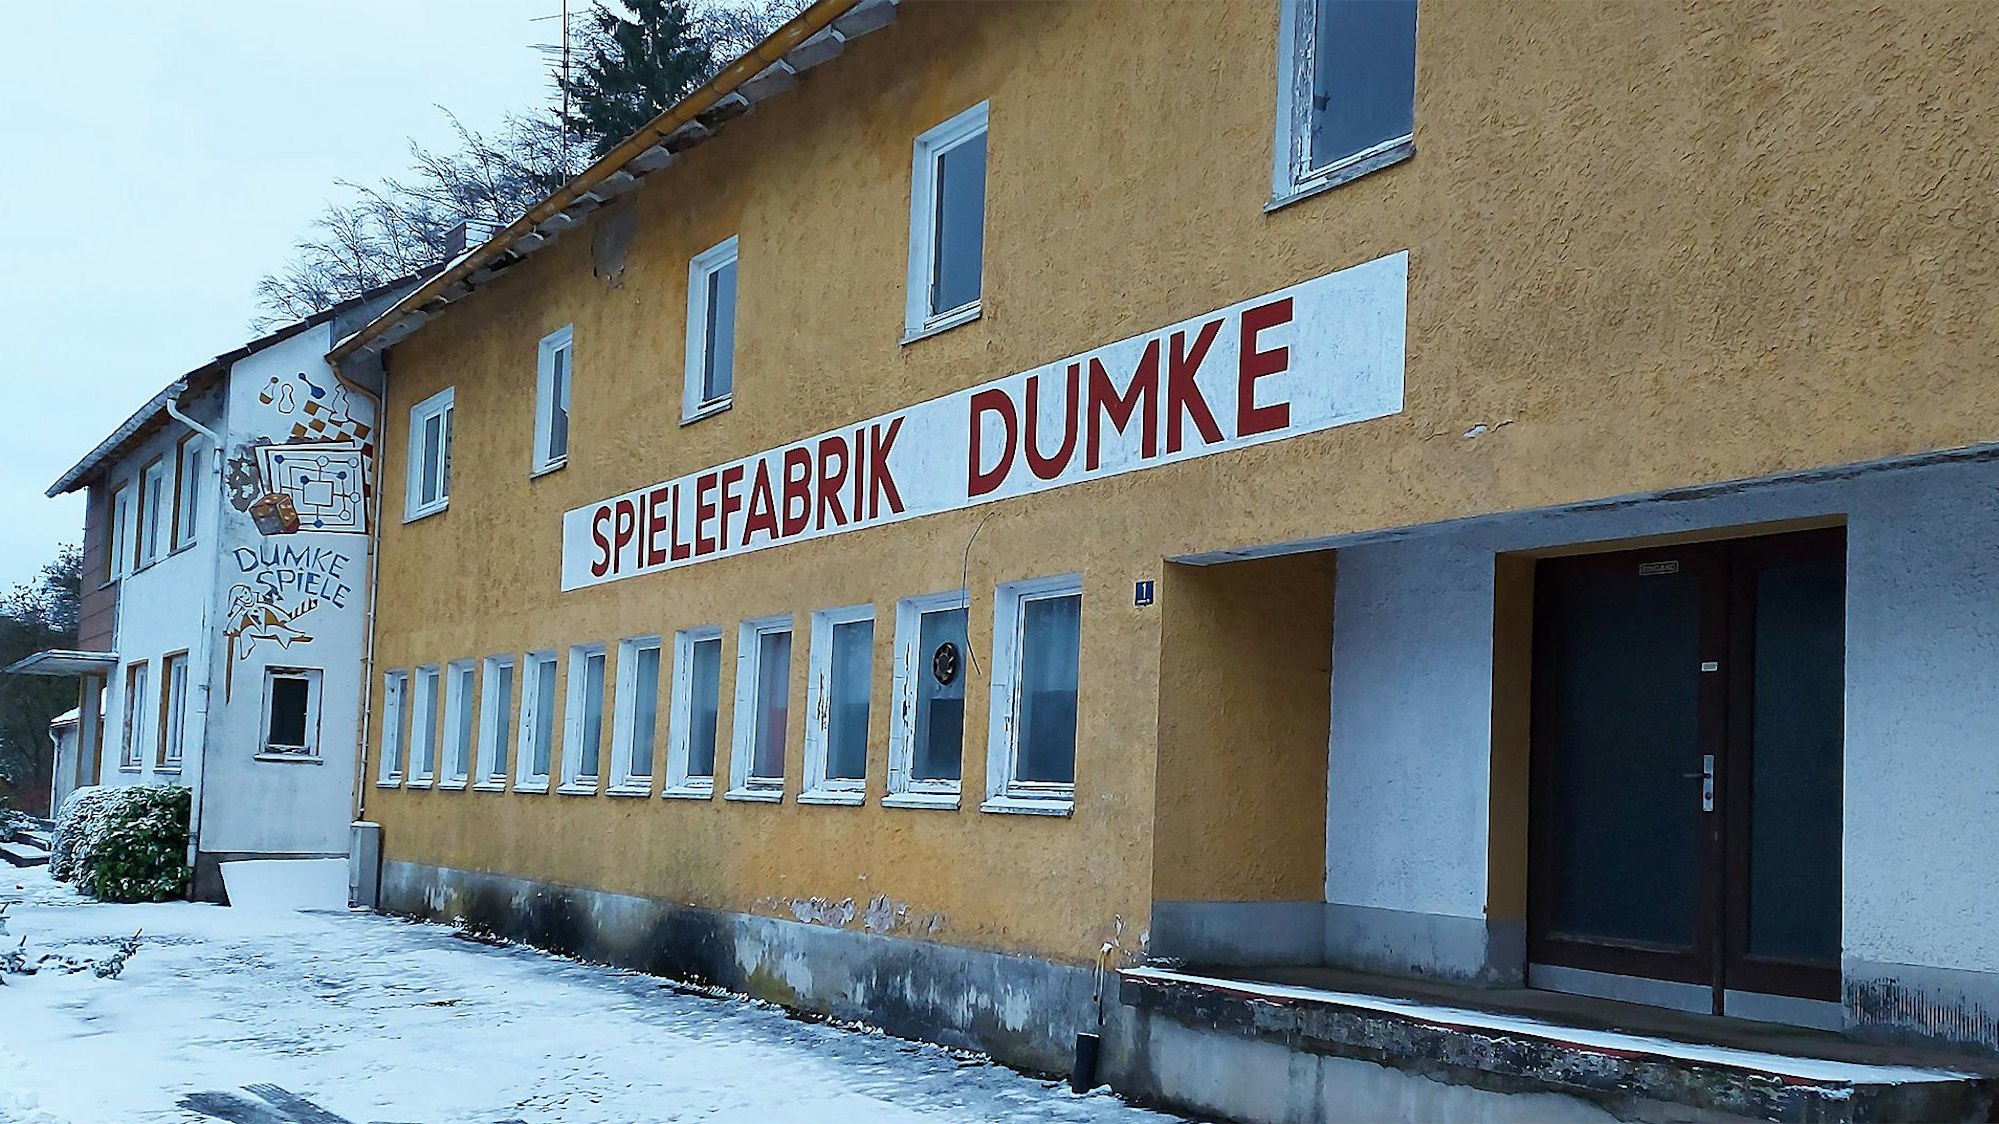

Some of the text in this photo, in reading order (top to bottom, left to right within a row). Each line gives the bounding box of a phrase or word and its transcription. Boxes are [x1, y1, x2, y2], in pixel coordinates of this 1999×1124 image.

[591, 299, 1294, 579] SPIELEFABRIK DUMKE
[232, 543, 351, 580] DUMKE
[1142, 582, 1147, 599] 1
